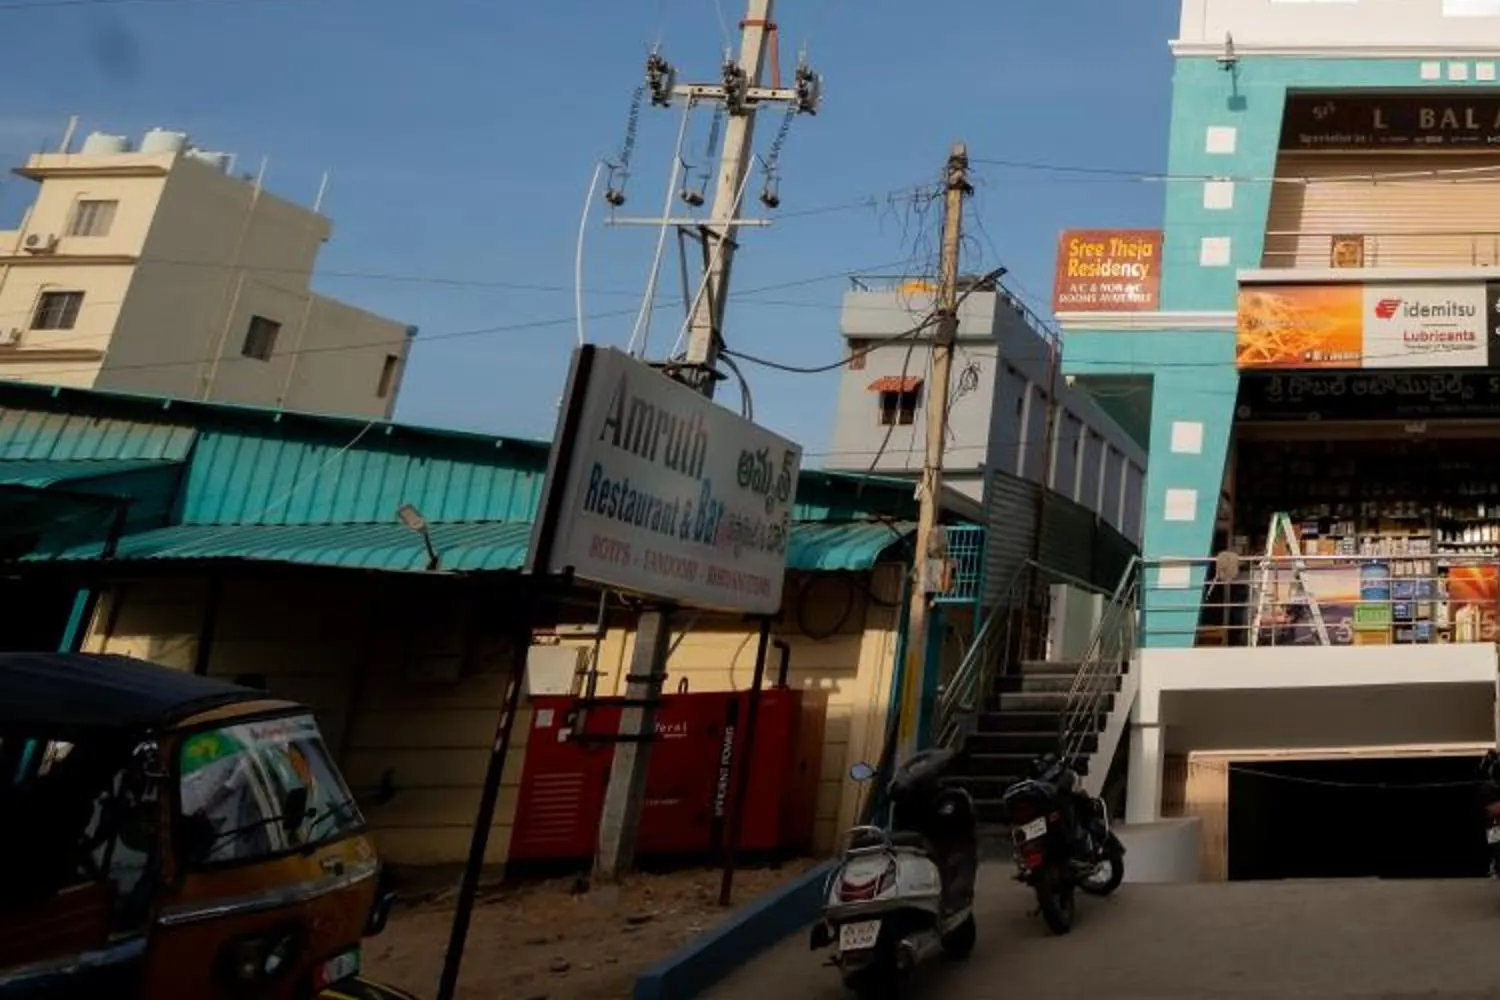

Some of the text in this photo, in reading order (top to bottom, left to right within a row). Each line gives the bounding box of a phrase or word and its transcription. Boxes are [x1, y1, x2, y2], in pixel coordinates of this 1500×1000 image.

[1069, 236, 1153, 260] Sree Theja
[1067, 257, 1150, 280] Residency
[1403, 299, 1476, 318] idemitsu
[1403, 329, 1476, 342] Lubricants
[598, 373, 710, 480] Amruth
[583, 461, 679, 536] Restaurant
[693, 476, 726, 547] Bar
